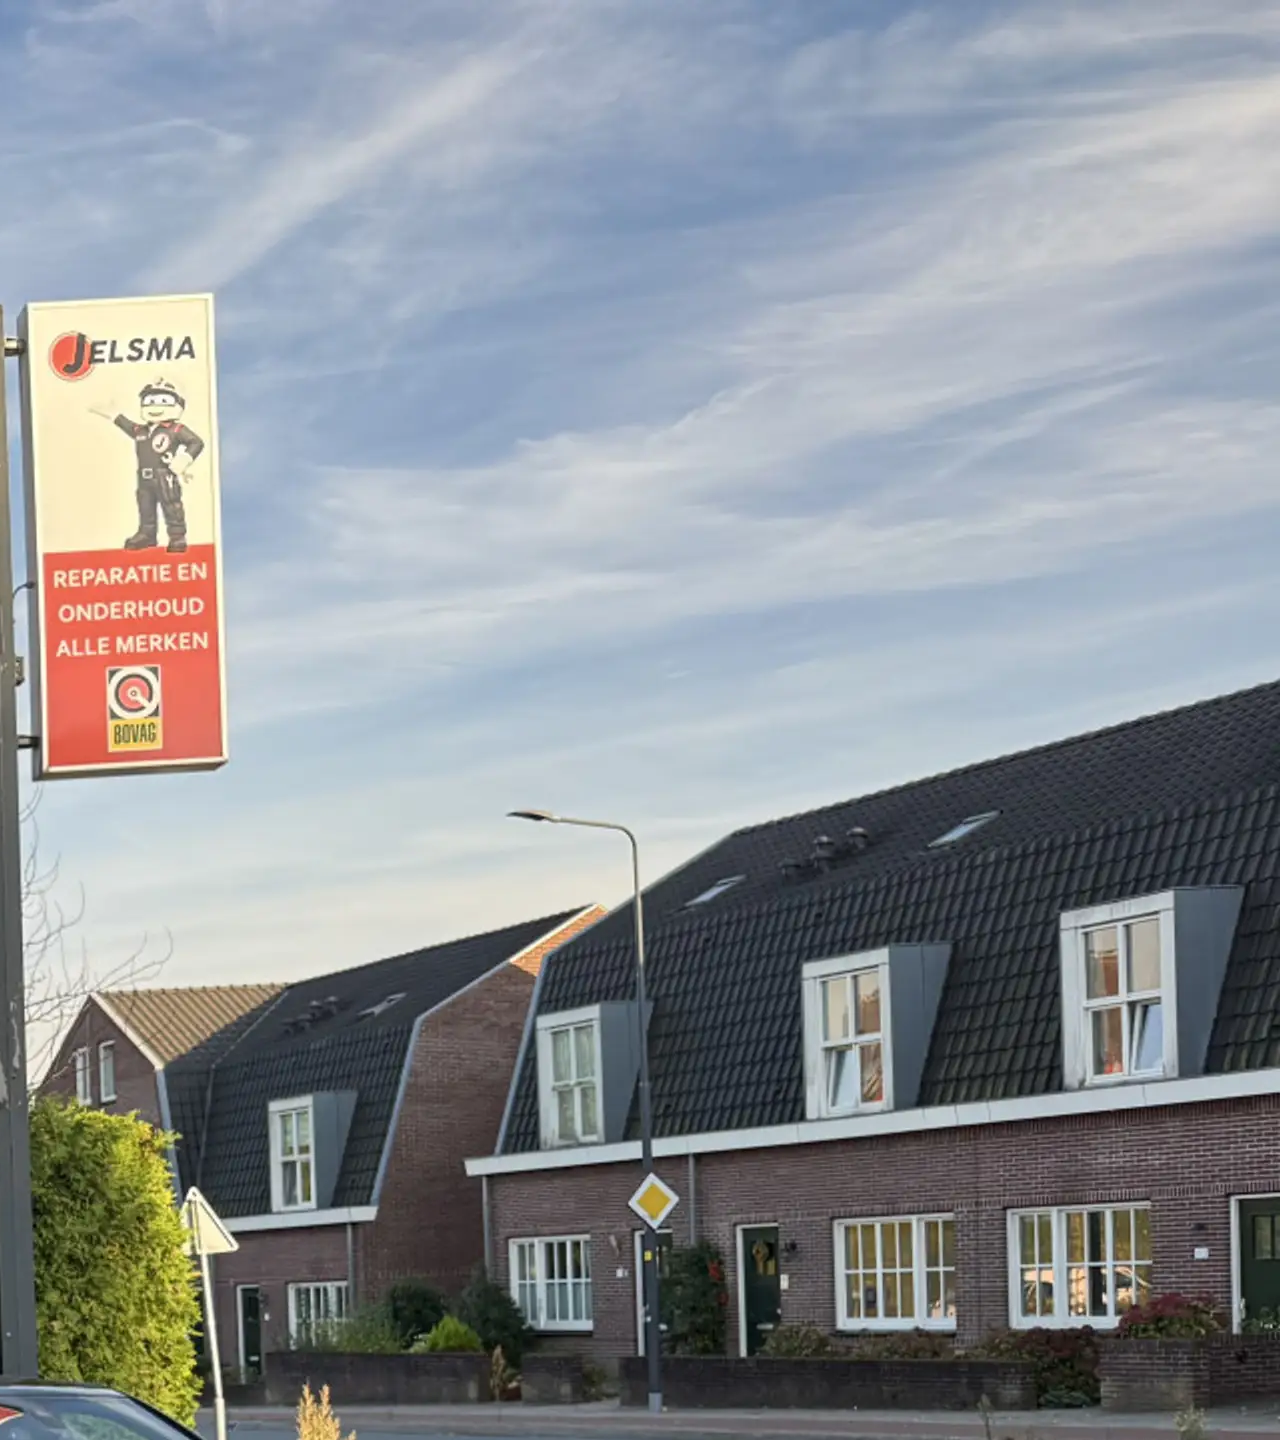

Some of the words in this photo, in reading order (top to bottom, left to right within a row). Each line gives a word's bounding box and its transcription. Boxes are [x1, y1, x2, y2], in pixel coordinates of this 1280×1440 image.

[62, 332, 196, 374] JELSMA
[52, 563, 172, 589] REPARATIE
[177, 561, 208, 582] EN
[57, 597, 205, 624] ONDERHOUD
[55, 636, 111, 658] ALLE
[115, 631, 209, 654] MERKEN
[114, 722, 157, 745] BOVAG
